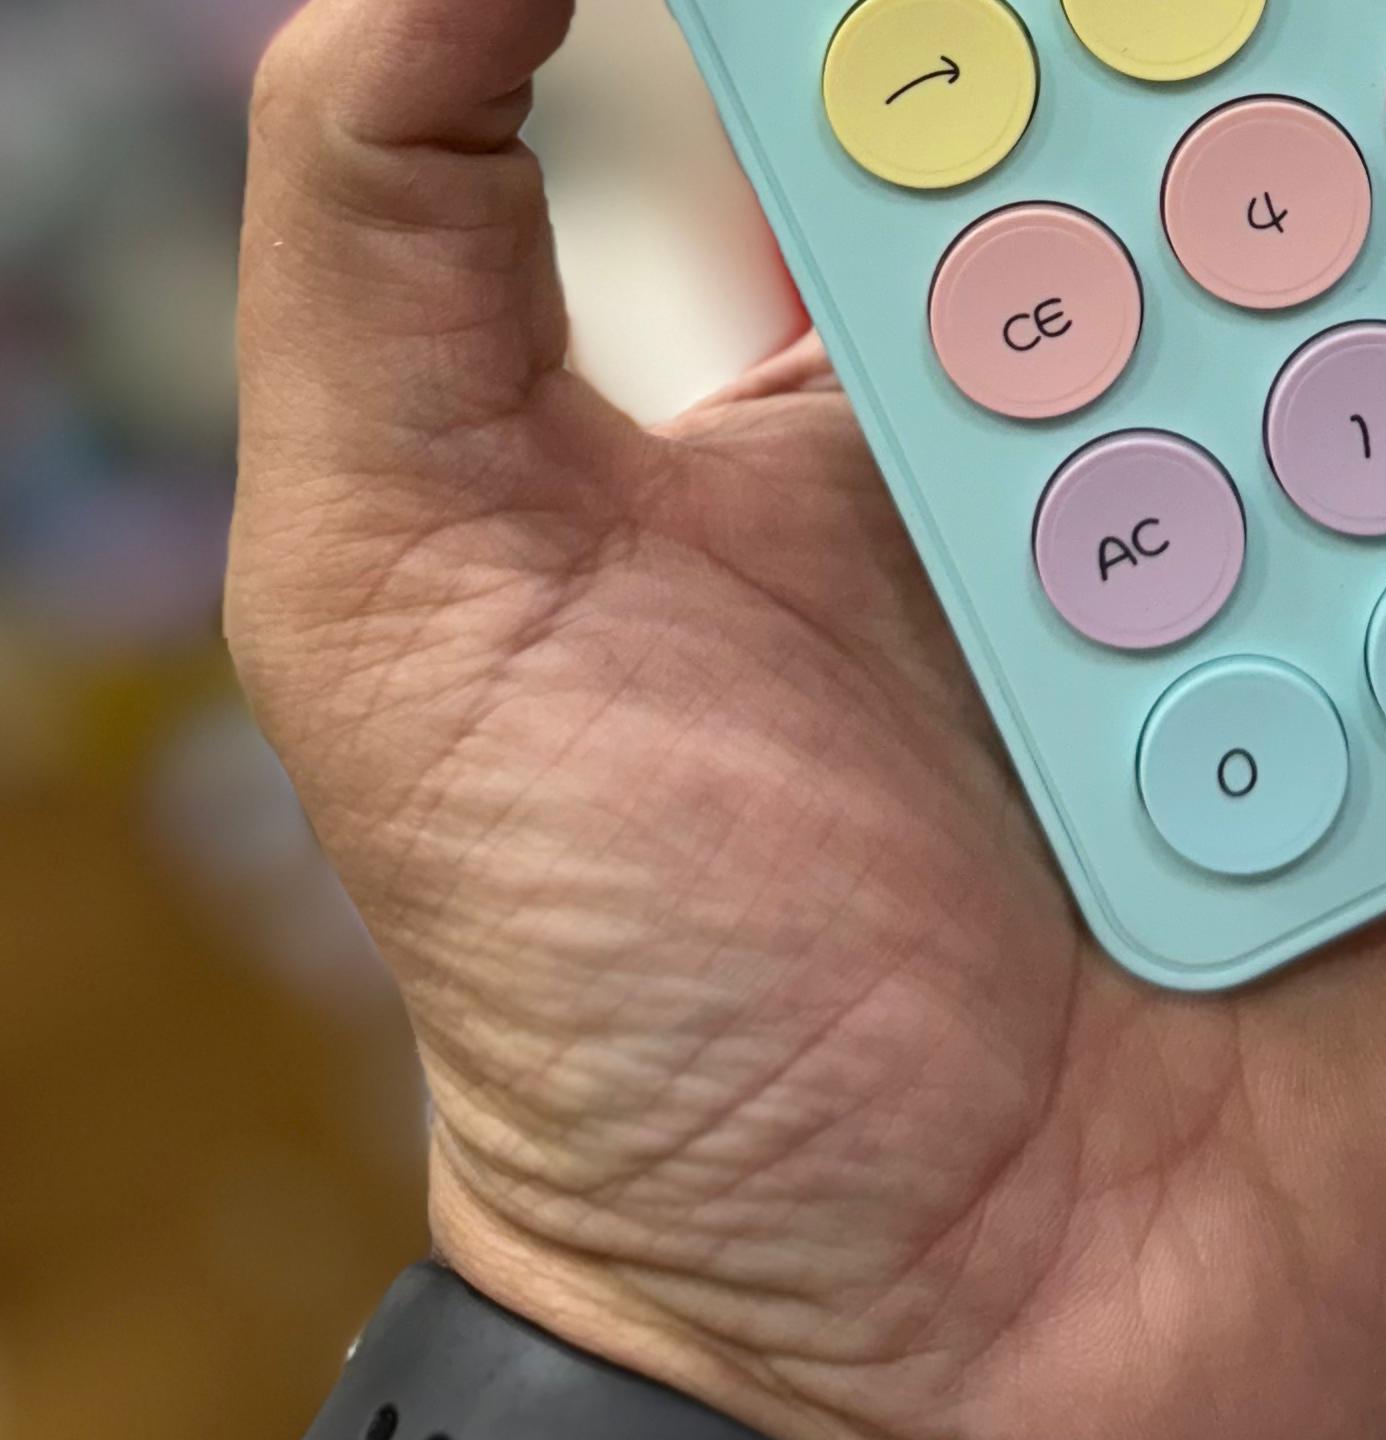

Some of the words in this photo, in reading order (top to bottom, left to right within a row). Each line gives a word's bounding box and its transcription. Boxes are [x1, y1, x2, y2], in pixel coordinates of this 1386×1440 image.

[1247, 191, 1288, 234] 4
[1002, 297, 1073, 352] CE
[1349, 414, 1371, 459] 1
[1098, 517, 1170, 582] AC
[1217, 748, 1258, 798] 0
